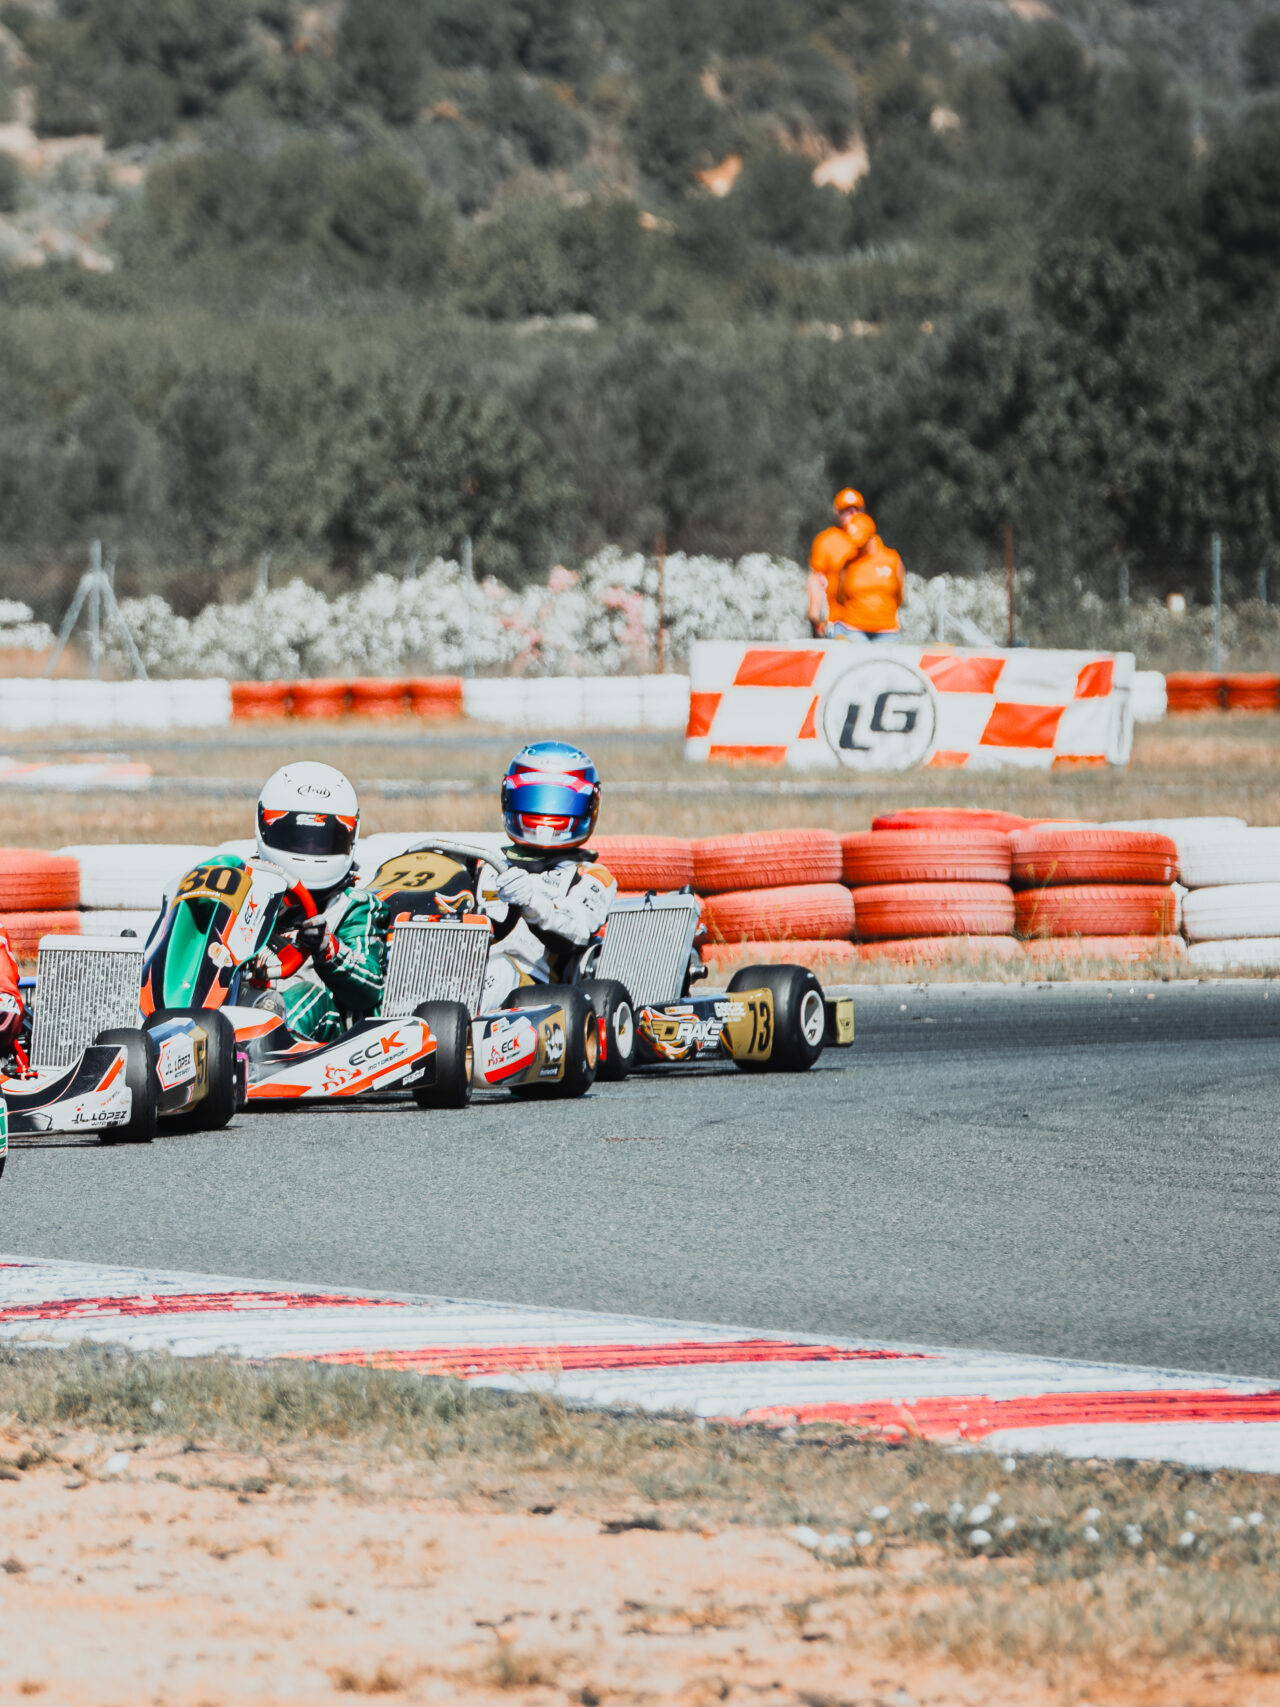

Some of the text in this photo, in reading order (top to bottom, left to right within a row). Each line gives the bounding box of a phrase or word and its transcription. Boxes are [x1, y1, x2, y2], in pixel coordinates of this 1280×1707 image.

[839, 690, 928, 751] LG
[177, 866, 242, 897] 30
[501, 1033, 520, 1054] ECK
[651, 1017, 724, 1046] DRAKE
[349, 1030, 407, 1066] ECK
